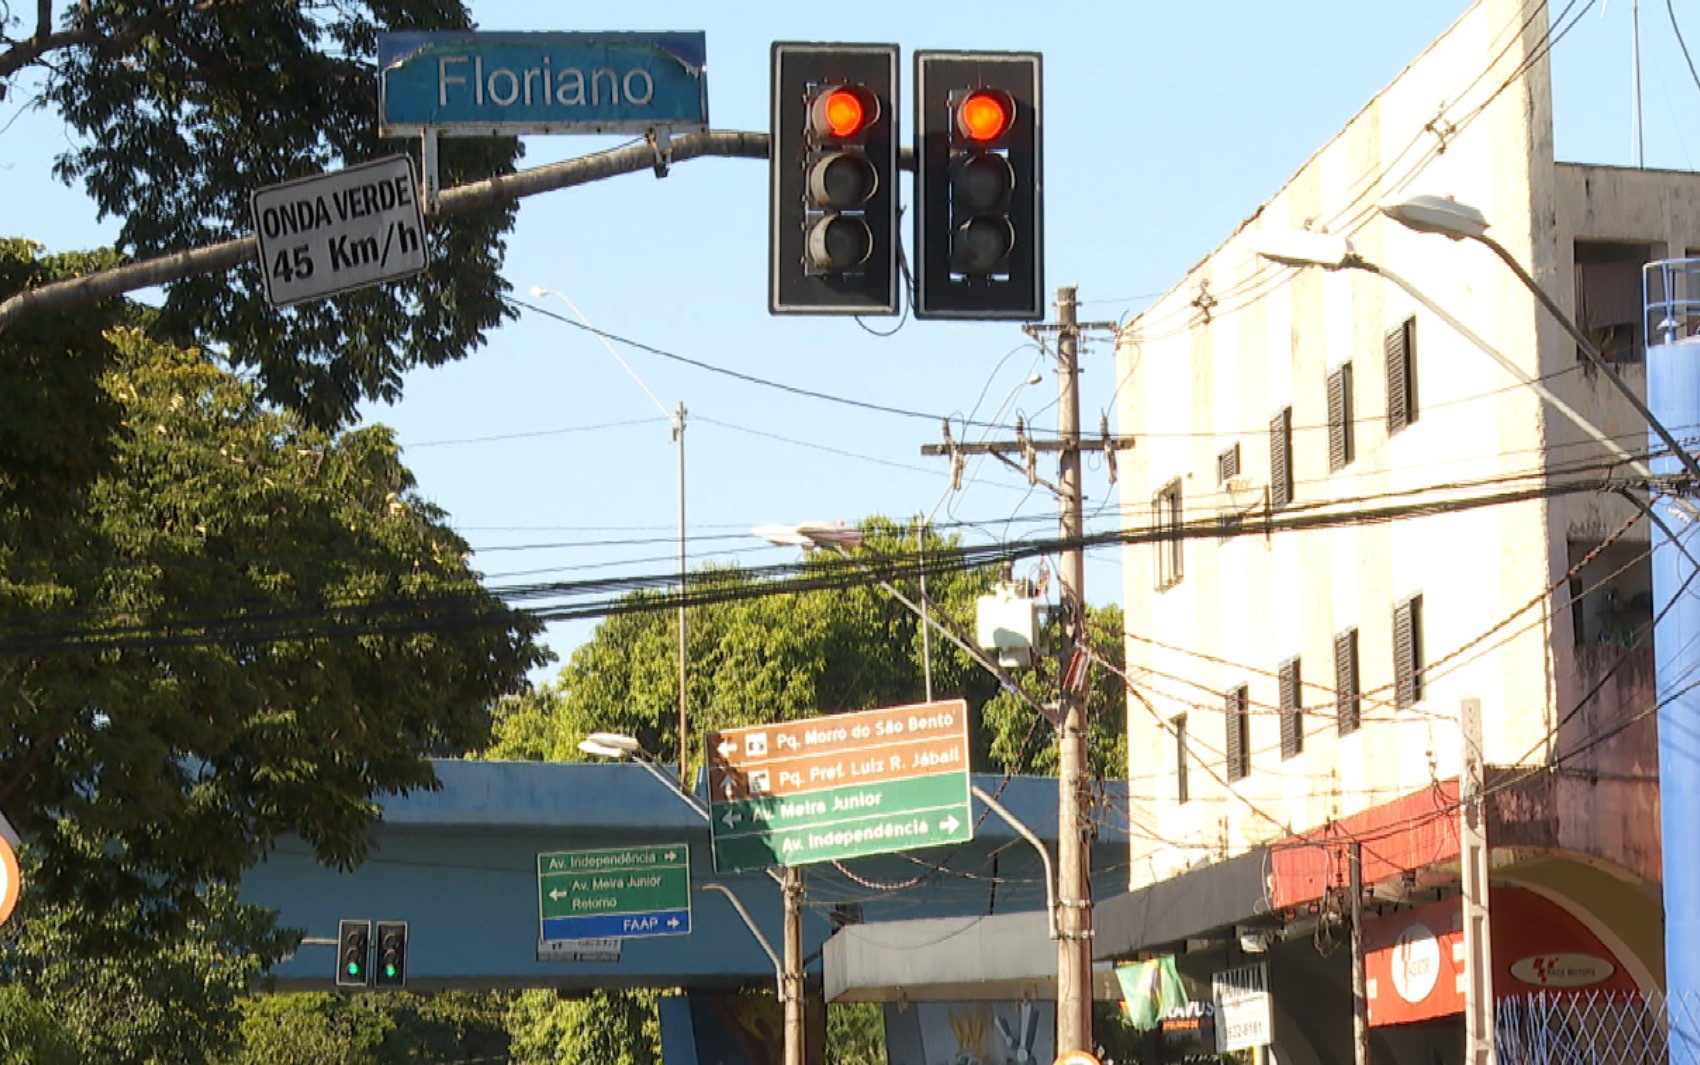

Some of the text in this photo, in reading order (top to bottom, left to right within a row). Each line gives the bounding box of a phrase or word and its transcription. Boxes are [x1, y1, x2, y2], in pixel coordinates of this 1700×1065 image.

[438, 55, 655, 108] Floriano
[262, 176, 412, 240] ONDA VERDE
[273, 221, 419, 284] 45 Km/h
[777, 713, 955, 750] Pq. Morro do São Bento
[780, 771, 805, 788] Pq.
[810, 765, 846, 784] Prof.
[851, 759, 884, 777] Luiz
[890, 755, 905, 770] R.
[752, 792, 883, 823] Av. Meira Junior
[782, 819, 928, 854] Av. Independência
[549, 852, 656, 870] Av. Independência
[572, 875, 662, 892] Av. Meira Junior
[572, 898, 617, 911] Retorno
[623, 918, 658, 932] FAAP
